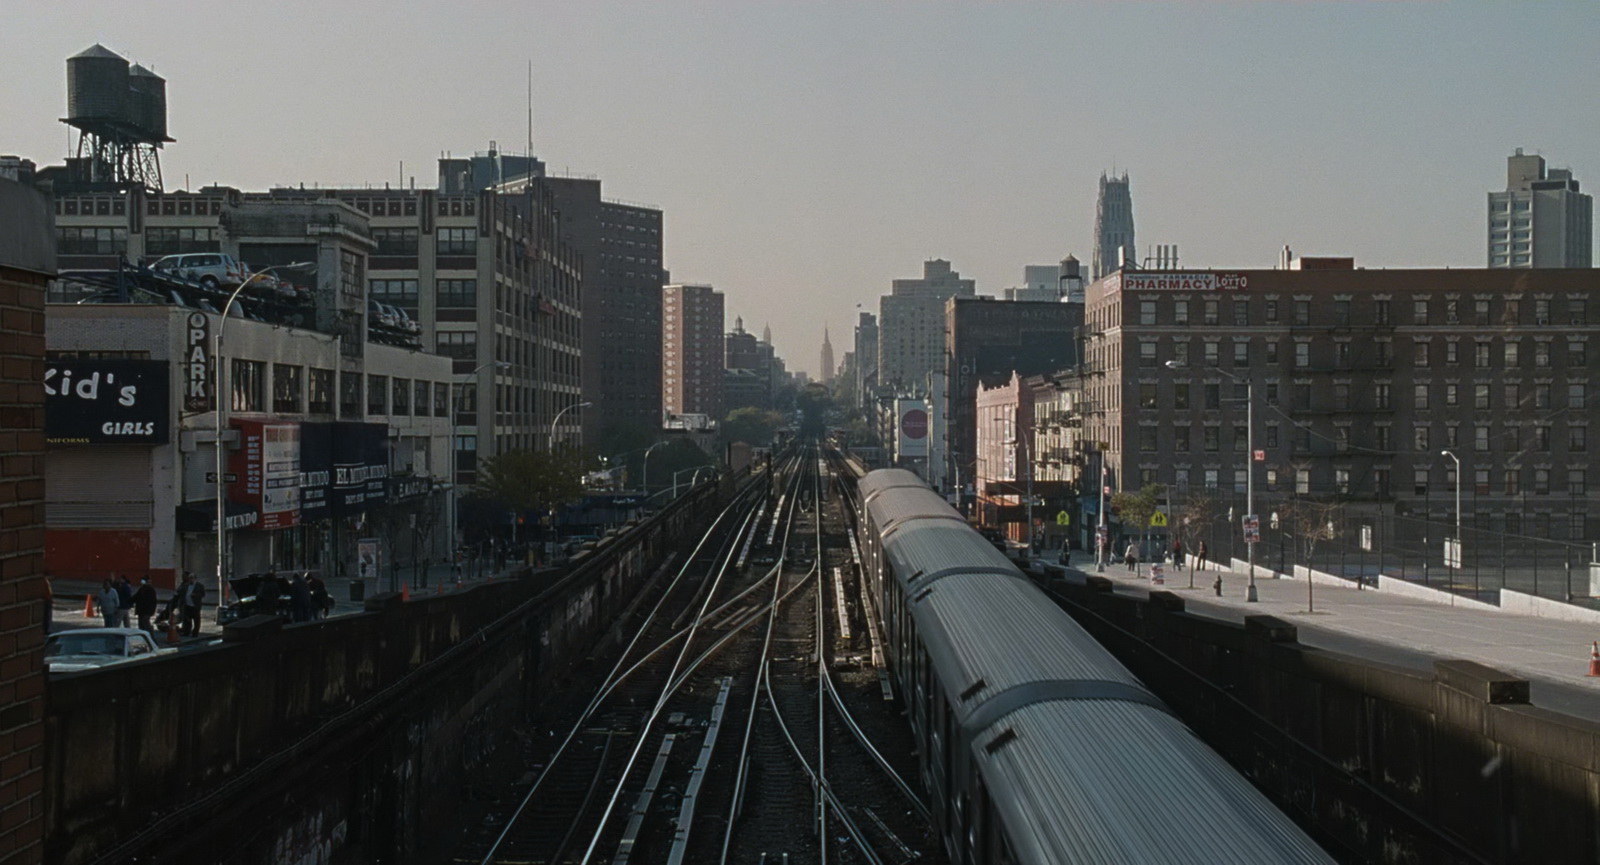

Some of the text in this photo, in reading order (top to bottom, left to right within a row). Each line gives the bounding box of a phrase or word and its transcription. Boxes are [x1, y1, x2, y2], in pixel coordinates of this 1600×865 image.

[1125, 280, 1213, 289] PHARMACY
[1216, 276, 1248, 288] LOTTO
[190, 329, 206, 397] PARK
[44, 368, 136, 406] Kid's
[102, 422, 154, 435] GIRLS
[336, 468, 349, 484] EL
[225, 511, 258, 529] MUNDO
